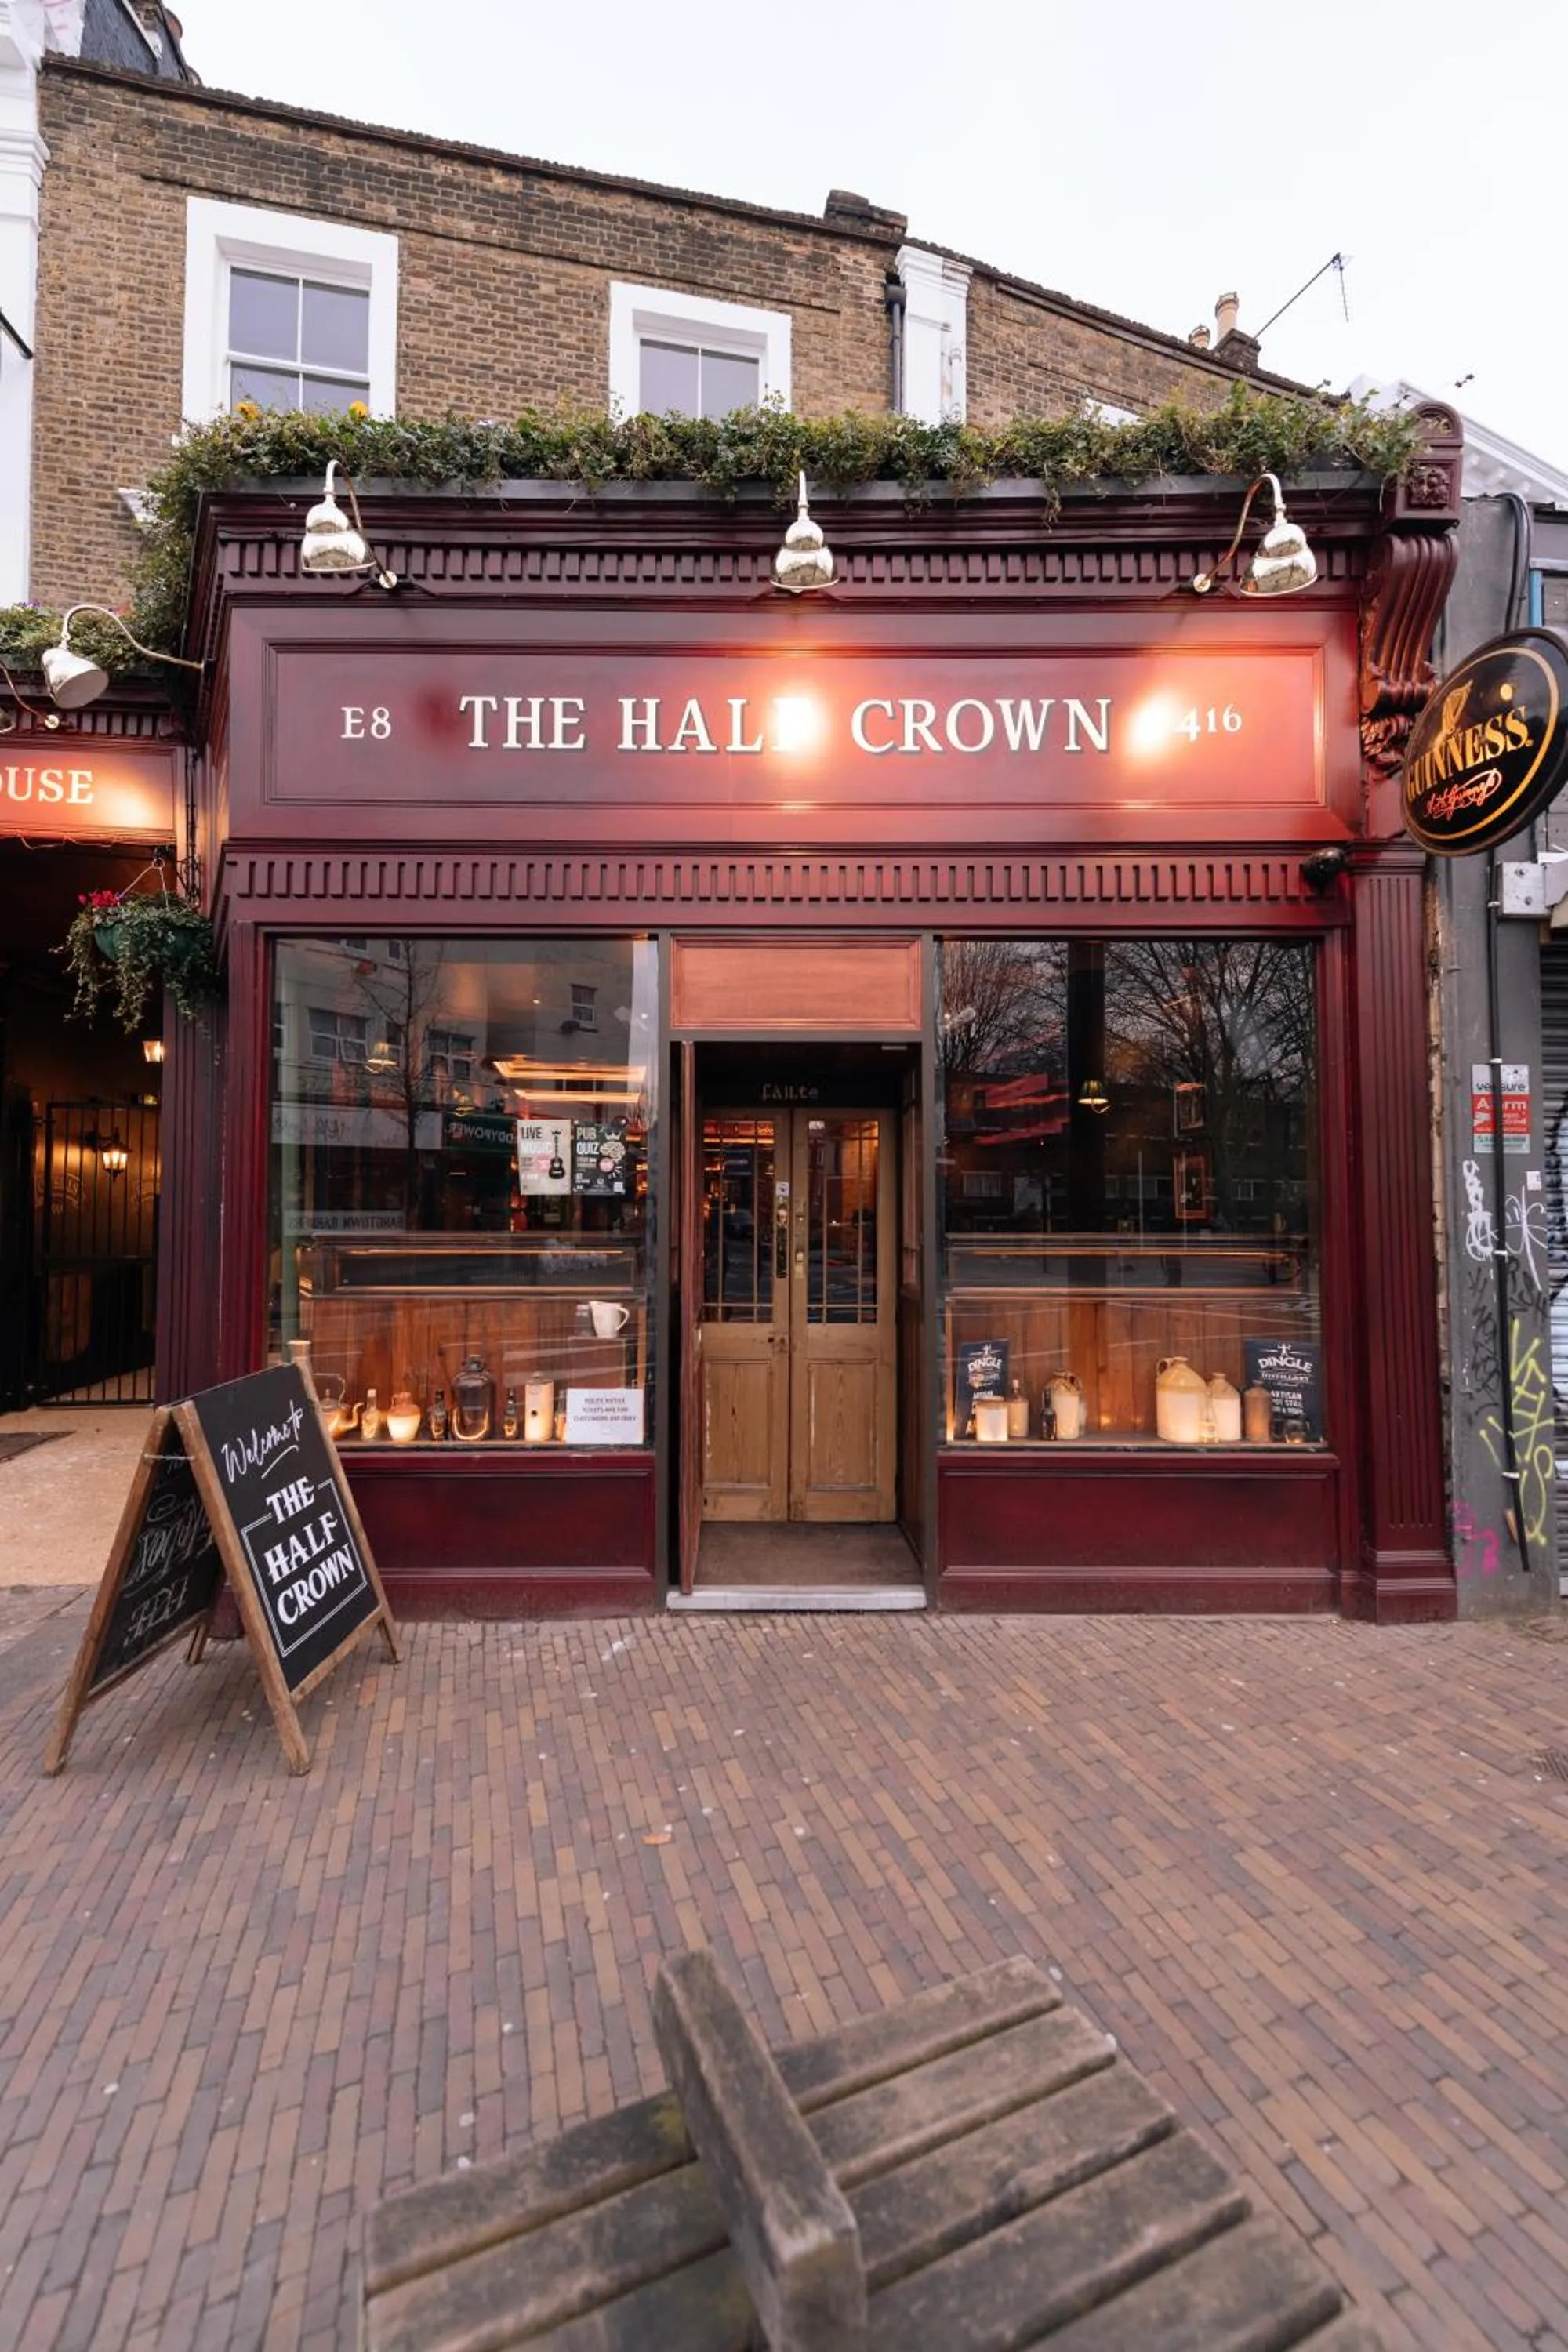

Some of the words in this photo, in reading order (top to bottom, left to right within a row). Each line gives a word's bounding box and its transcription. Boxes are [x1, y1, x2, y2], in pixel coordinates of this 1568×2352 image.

[341, 707, 392, 739] E8
[459, 696, 586, 750] THE
[851, 698, 1112, 753] CROWN
[1174, 705, 1243, 742] 416
[0, 766, 94, 804] USE
[1476, 1097, 1527, 1112] Arm
[521, 1126, 543, 1140] LIVE
[577, 1127, 597, 1140] PUB
[577, 1141, 600, 1155] QUIZ
[1258, 1356, 1313, 1373] DINGLE
[220, 1423, 291, 1483] Welcome
[265, 1476, 315, 1524] THE
[263, 1511, 338, 1585] HALF
[276, 1541, 355, 1626] CROWN
